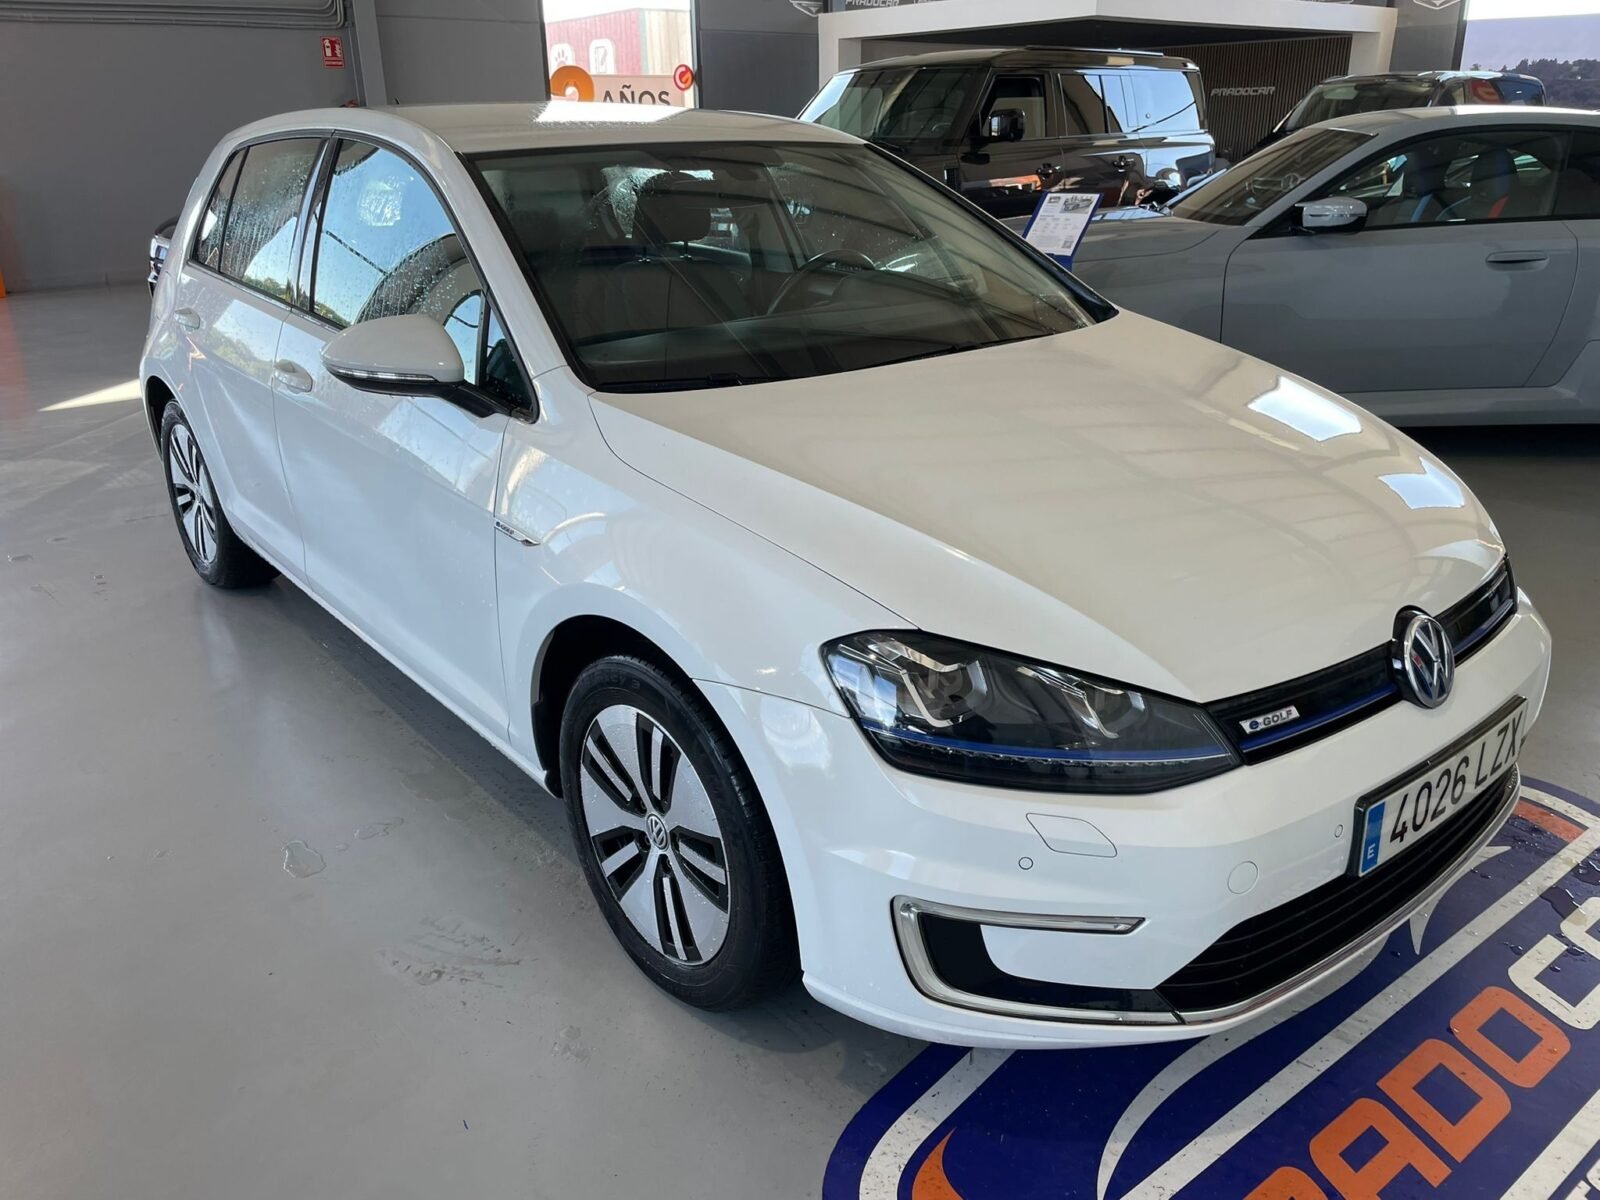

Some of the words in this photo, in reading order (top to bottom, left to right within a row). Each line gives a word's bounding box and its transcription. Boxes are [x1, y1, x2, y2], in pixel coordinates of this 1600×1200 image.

[1210, 86, 1275, 96] PRADOCAR
[1390, 756, 1469, 843] 4026
[1475, 711, 1523, 789] LZX
[1367, 843, 1376, 859] E
